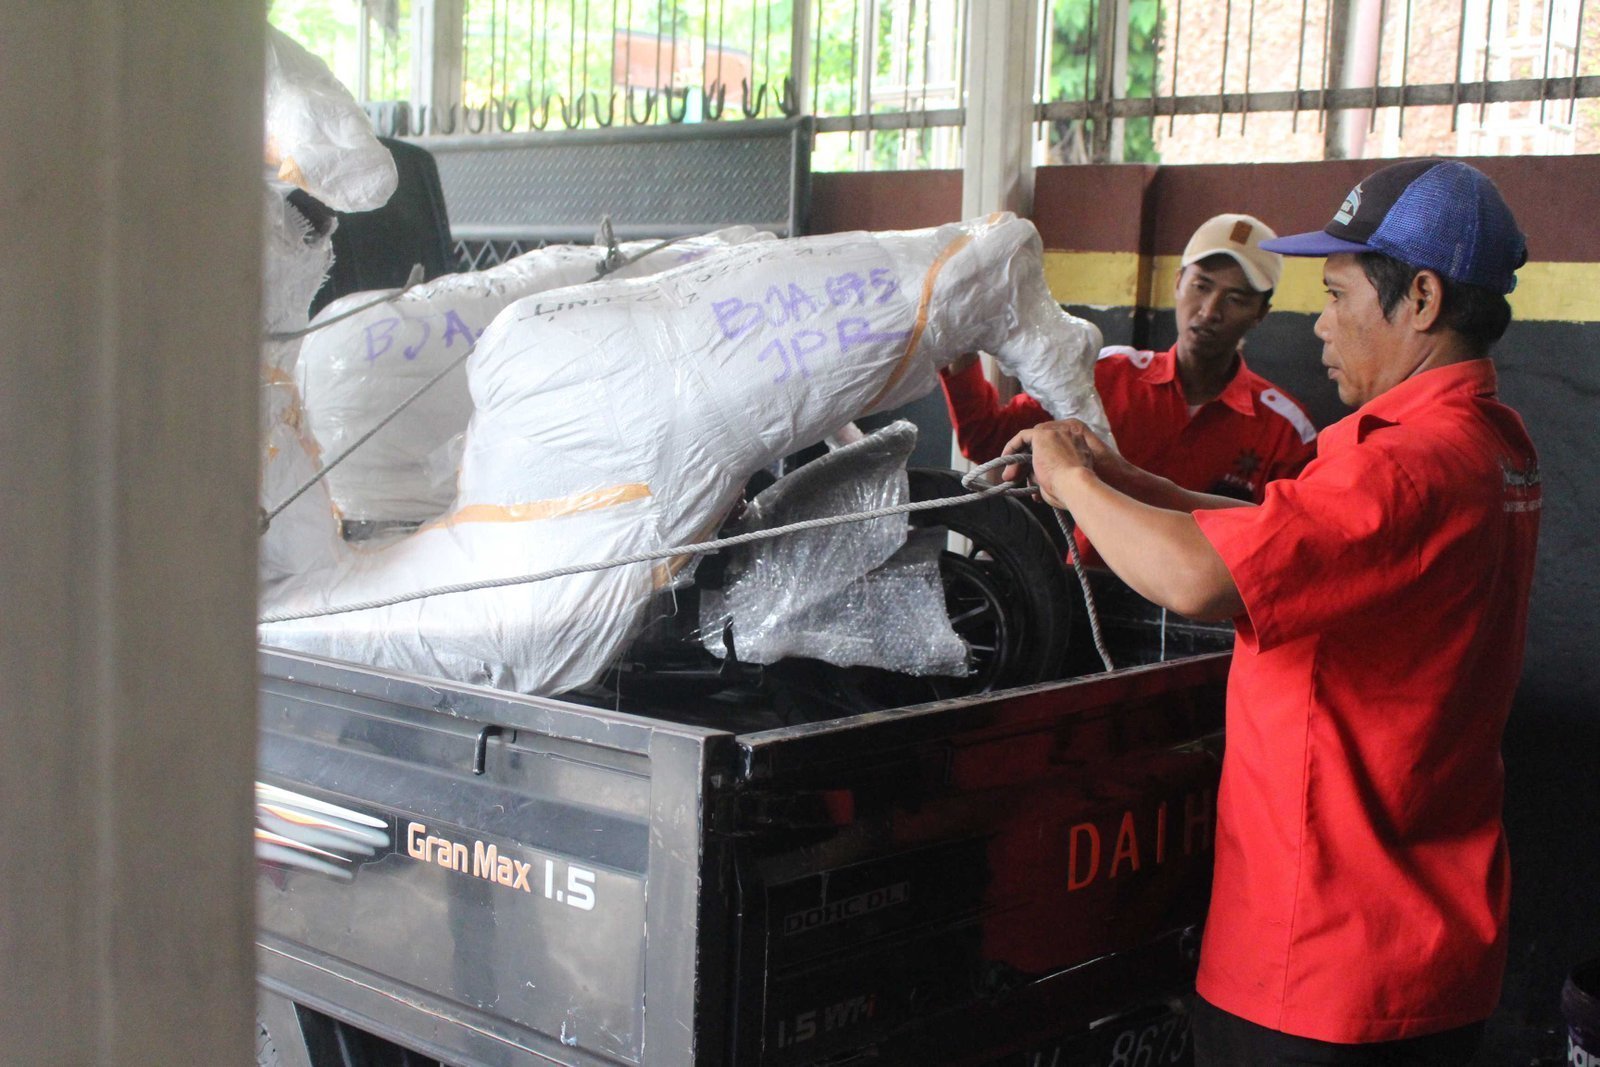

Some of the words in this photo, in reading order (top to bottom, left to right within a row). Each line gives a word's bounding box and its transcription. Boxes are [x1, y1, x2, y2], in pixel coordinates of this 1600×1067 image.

[757, 316, 914, 384] JPR
[407, 821, 468, 873] Gran
[473, 840, 531, 893] Max
[544, 859, 595, 911] 1.5
[786, 896, 861, 932] DOHC
[778, 1010, 816, 1048] 1.5
